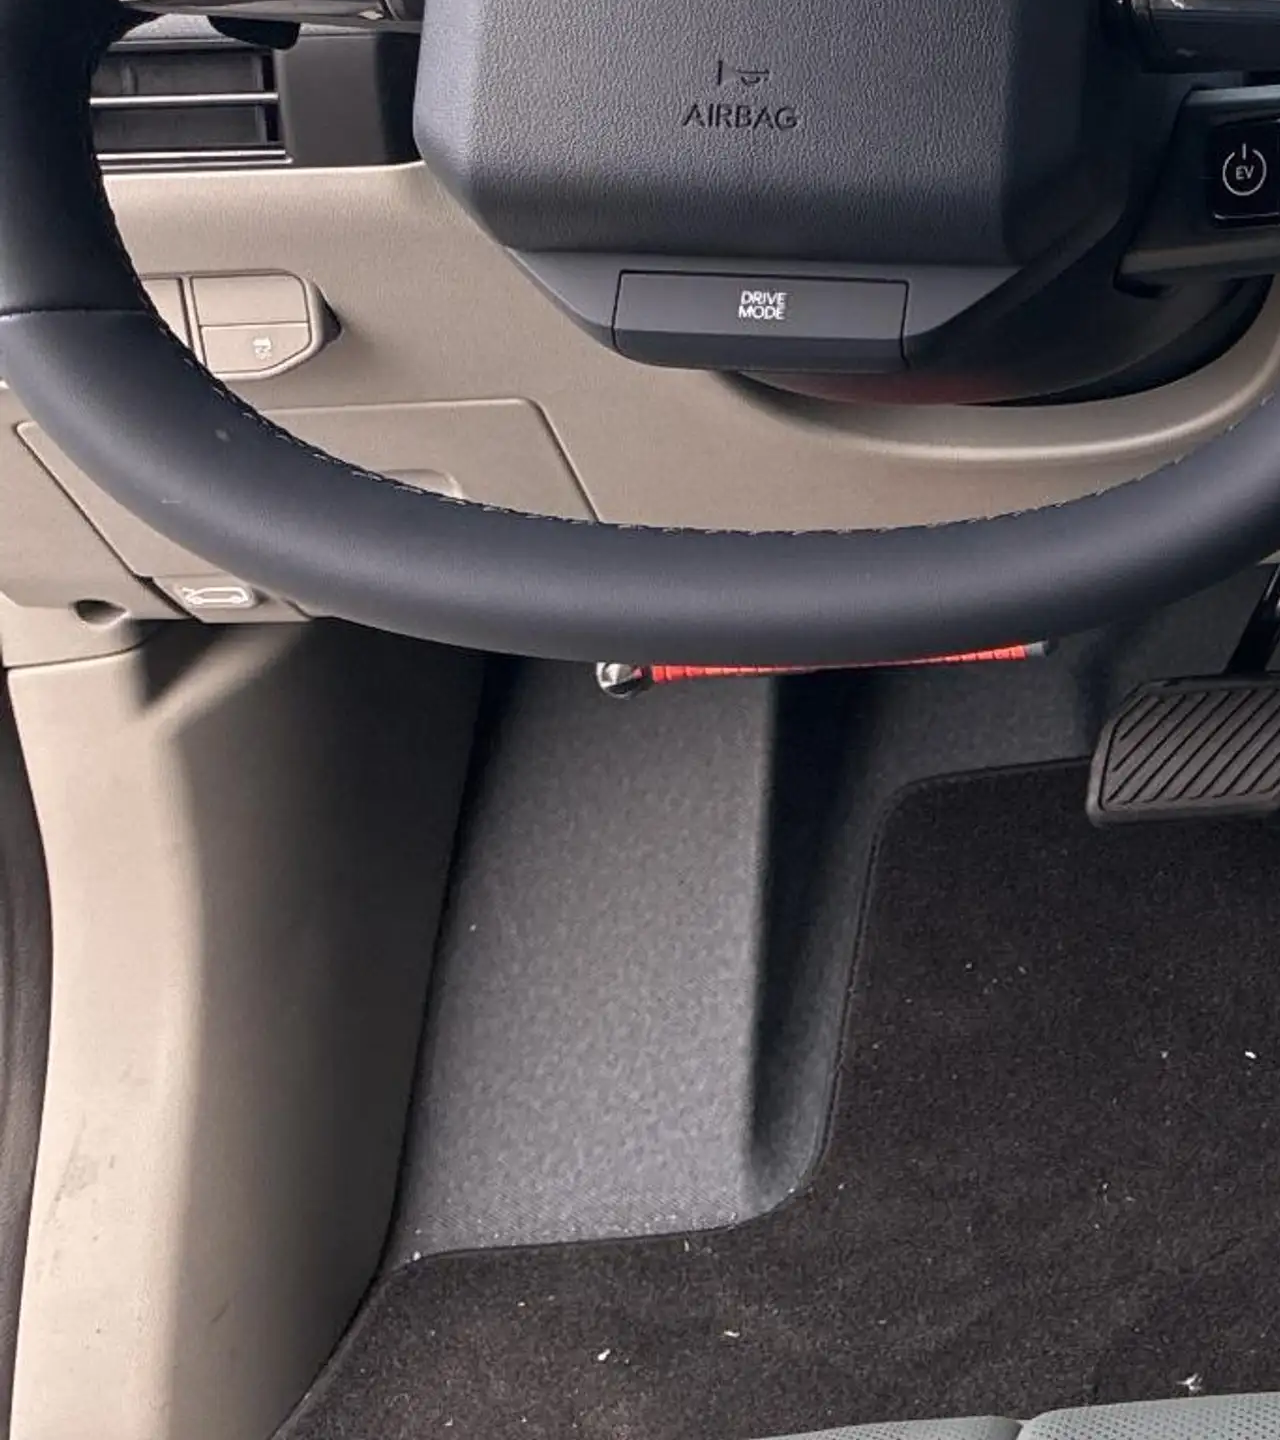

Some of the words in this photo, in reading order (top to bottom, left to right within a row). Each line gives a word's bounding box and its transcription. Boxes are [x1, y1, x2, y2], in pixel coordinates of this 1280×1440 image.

[682, 103, 798, 129] AIRBAG
[1235, 166, 1256, 181] EV
[740, 290, 787, 306] DRIVE
[738, 304, 786, 320] MODE
